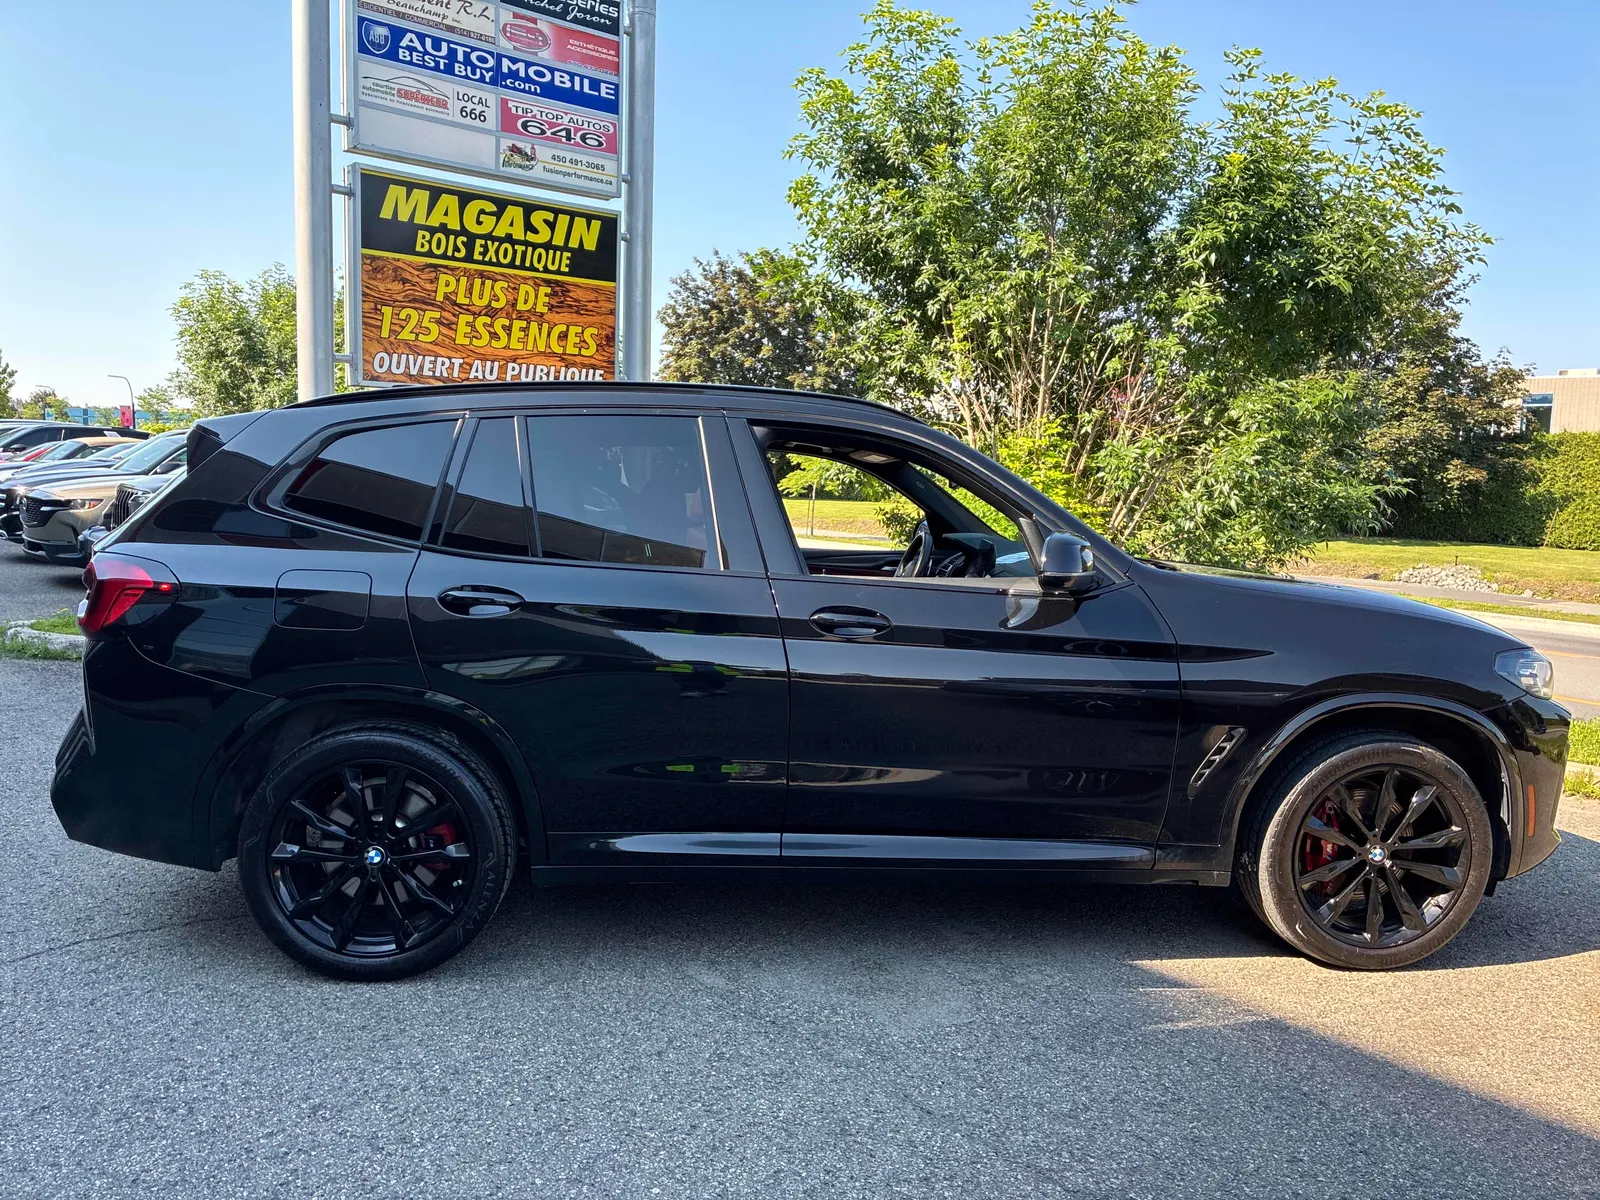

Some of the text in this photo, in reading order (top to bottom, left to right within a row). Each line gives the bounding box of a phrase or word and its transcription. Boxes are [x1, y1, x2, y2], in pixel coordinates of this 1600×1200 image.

[405, 13, 447, 30] COMMERCIAL
[525, 0, 612, 25] ichel Joron
[369, 30, 385, 44] ABB
[398, 48, 540, 93] BEST BUY .com
[362, 85, 395, 97] automobile
[372, 82, 396, 92] courtier
[456, 91, 490, 108] LOCAL
[460, 106, 487, 123] 666
[512, 105, 611, 133] TIP TOP AUTOS
[520, 119, 606, 148] 646
[543, 165, 613, 186] fusionperformance.ca
[551, 154, 606, 172] 450 491-3065
[379, 184, 601, 251] MAGASIN
[415, 230, 571, 272] BOIS EXOTIQUE
[436, 273, 551, 313] PLUS DE
[380, 305, 599, 356] 125 ESSENCES
[373, 352, 464, 378] OUVERT
[469, 360, 499, 380] AU
